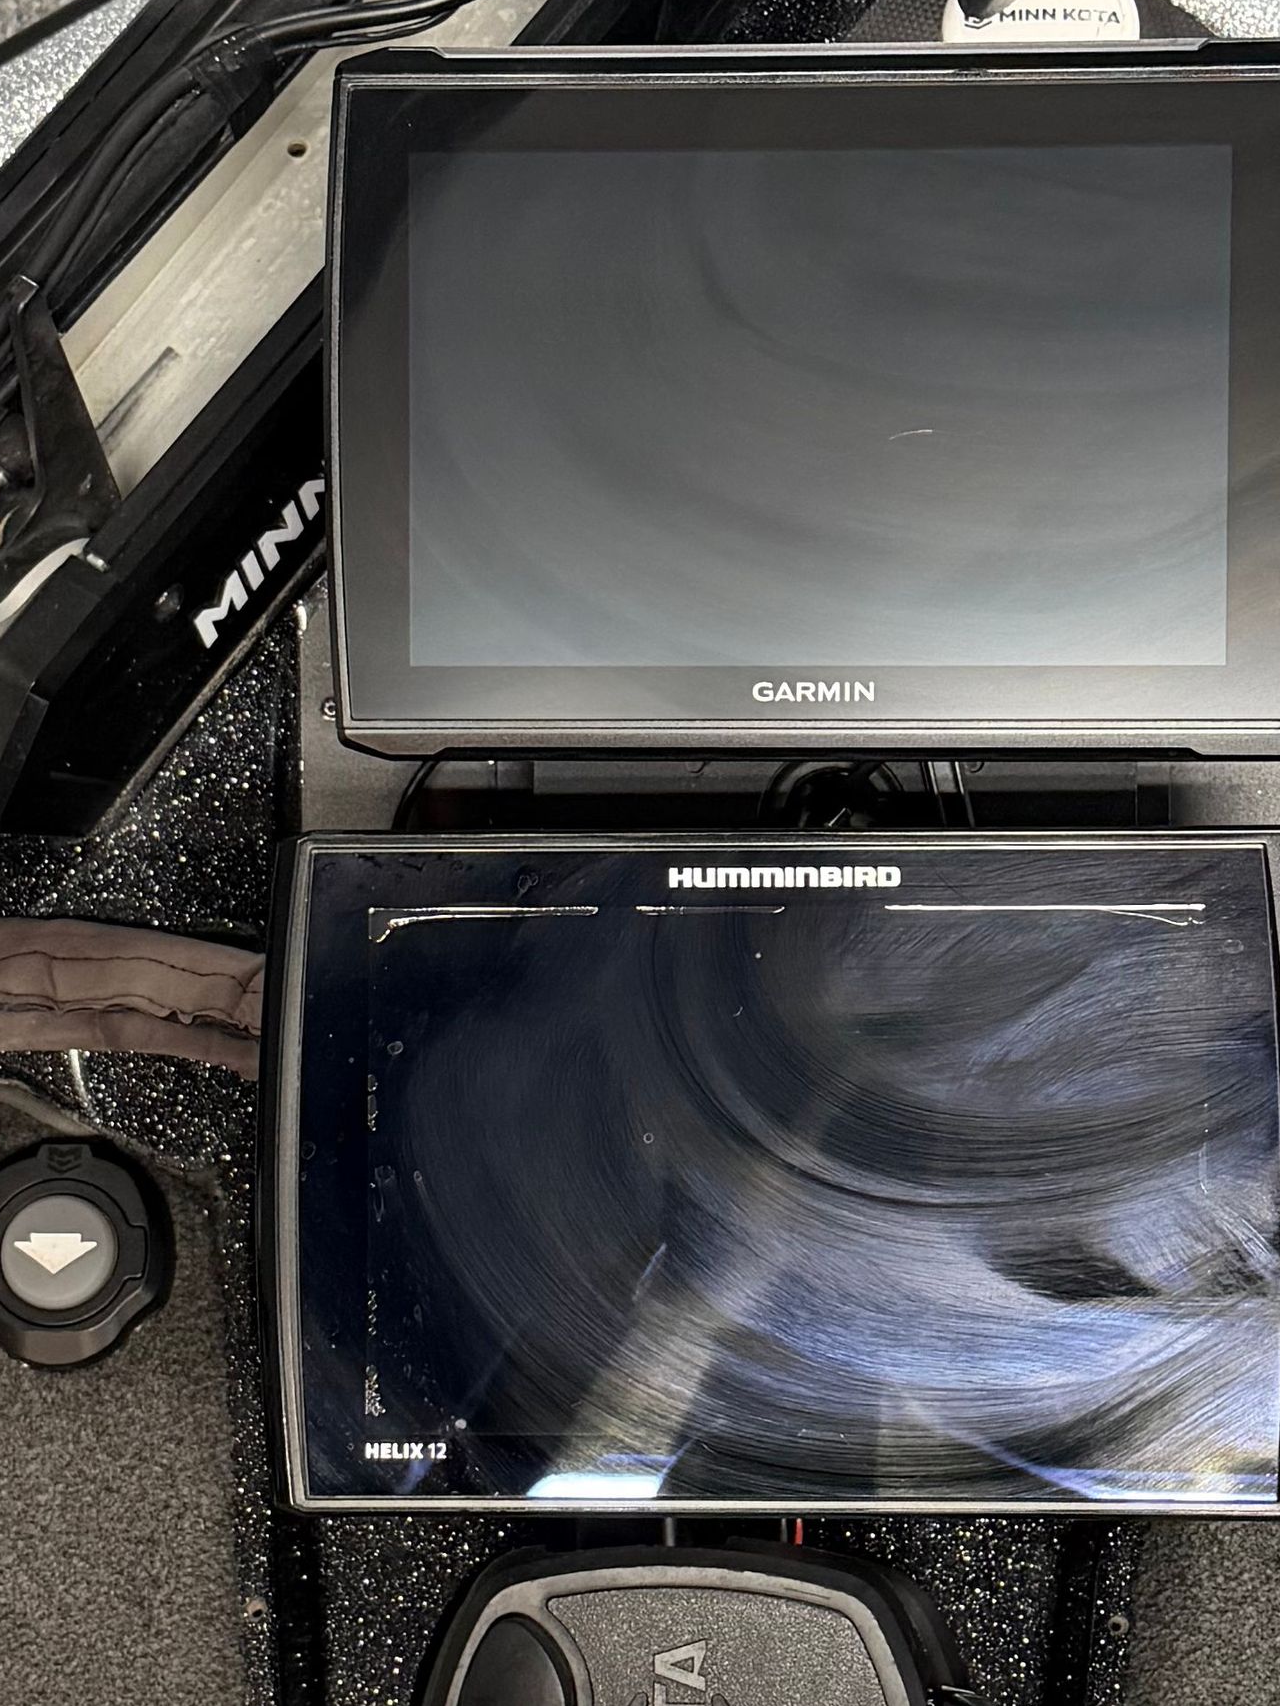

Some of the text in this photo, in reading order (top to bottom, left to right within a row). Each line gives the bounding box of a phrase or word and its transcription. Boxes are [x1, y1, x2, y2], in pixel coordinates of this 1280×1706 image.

[1000, 8, 1121, 24] MINN KOTA
[752, 681, 875, 702] GARMIN
[669, 866, 902, 888] HUMMINBIRD
[365, 1442, 447, 1460] HELIX 12
